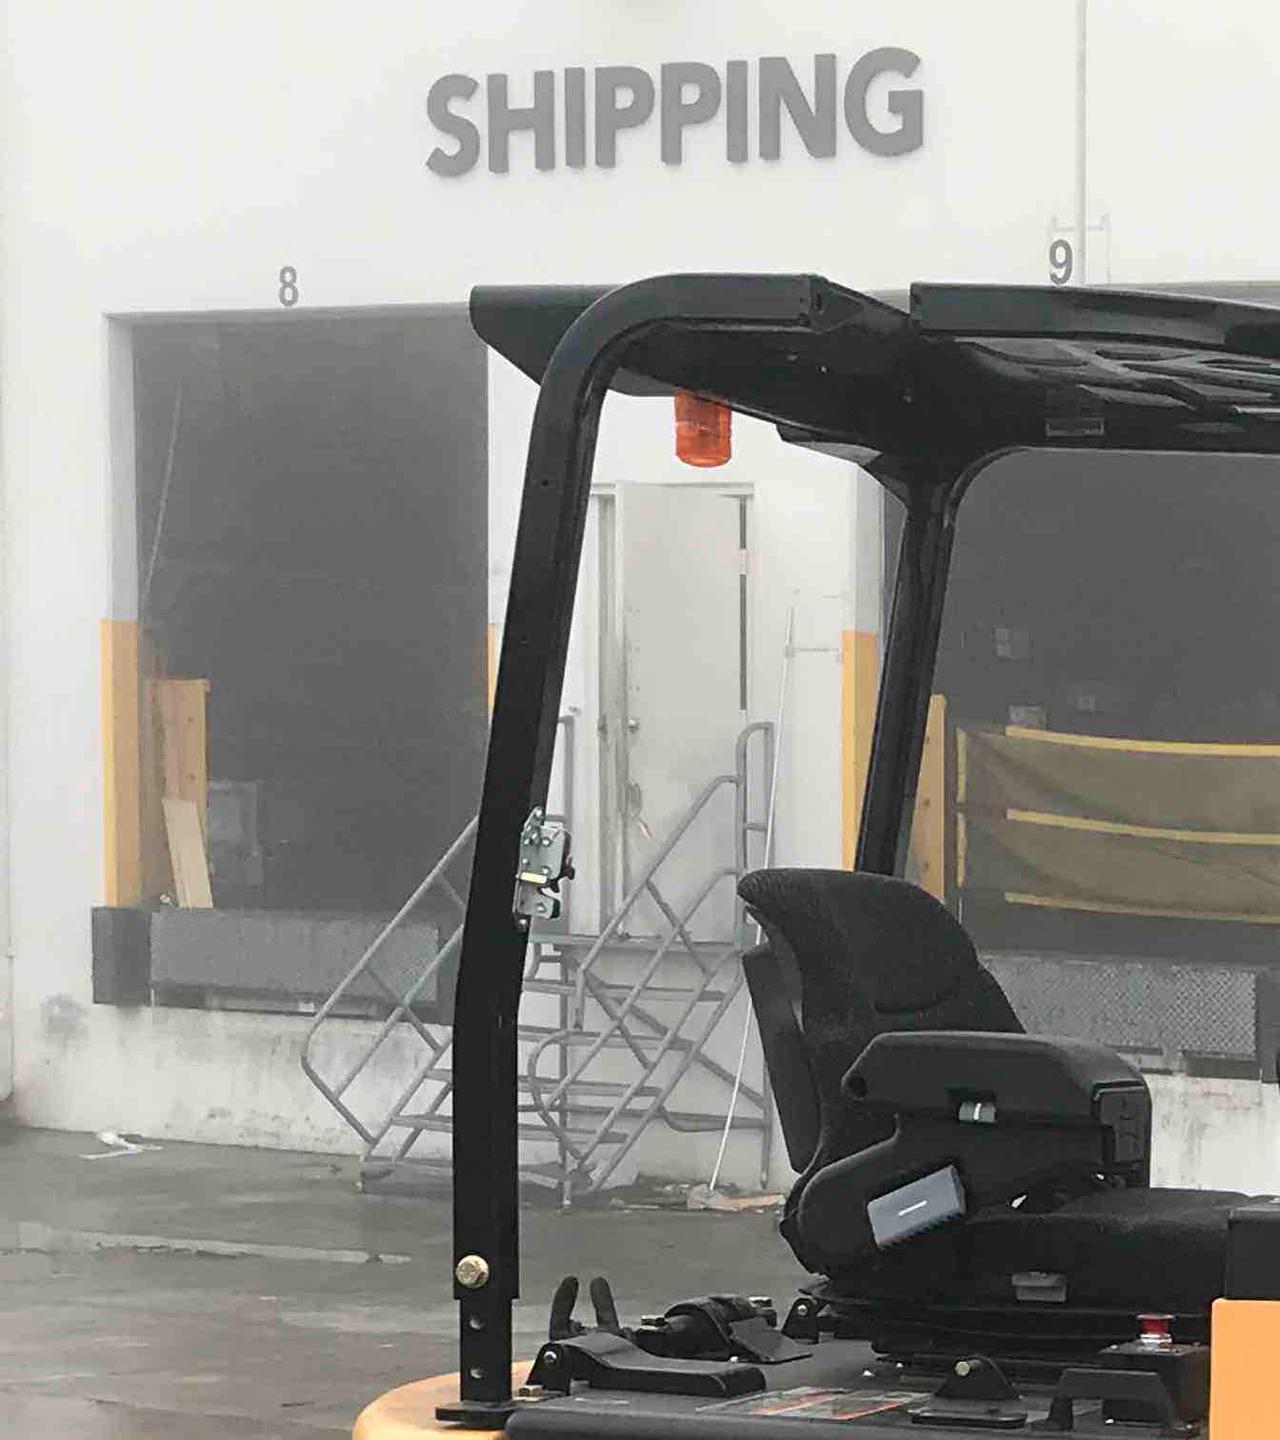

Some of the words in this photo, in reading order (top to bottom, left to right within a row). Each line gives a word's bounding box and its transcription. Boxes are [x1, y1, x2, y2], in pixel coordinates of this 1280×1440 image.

[426, 46, 925, 177] SHIPPING
[1049, 239, 1073, 285] 9
[279, 266, 299, 307] 8
